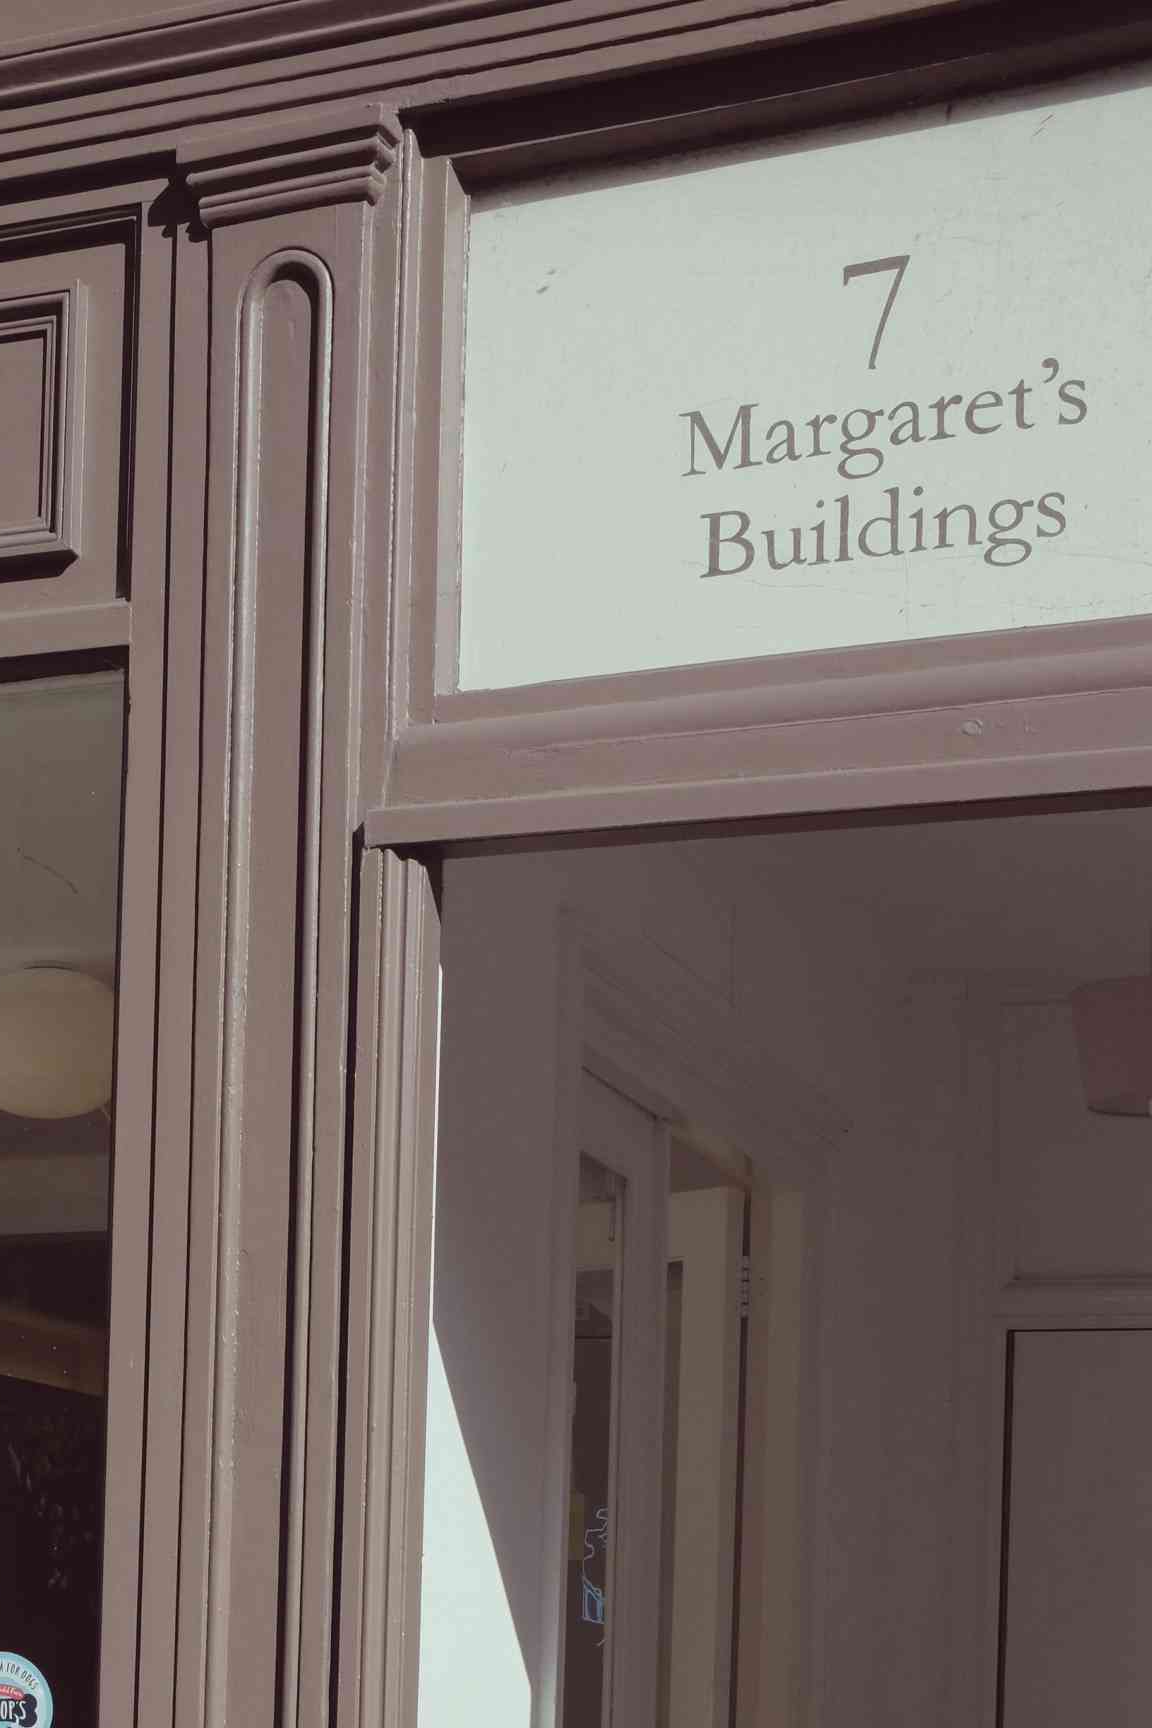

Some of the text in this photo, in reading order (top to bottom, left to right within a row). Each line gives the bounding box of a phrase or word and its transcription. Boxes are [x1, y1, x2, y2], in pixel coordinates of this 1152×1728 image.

[843, 255, 910, 369] 7
[678, 358, 1087, 479] Margaret's
[700, 486, 1067, 578] Buildings
